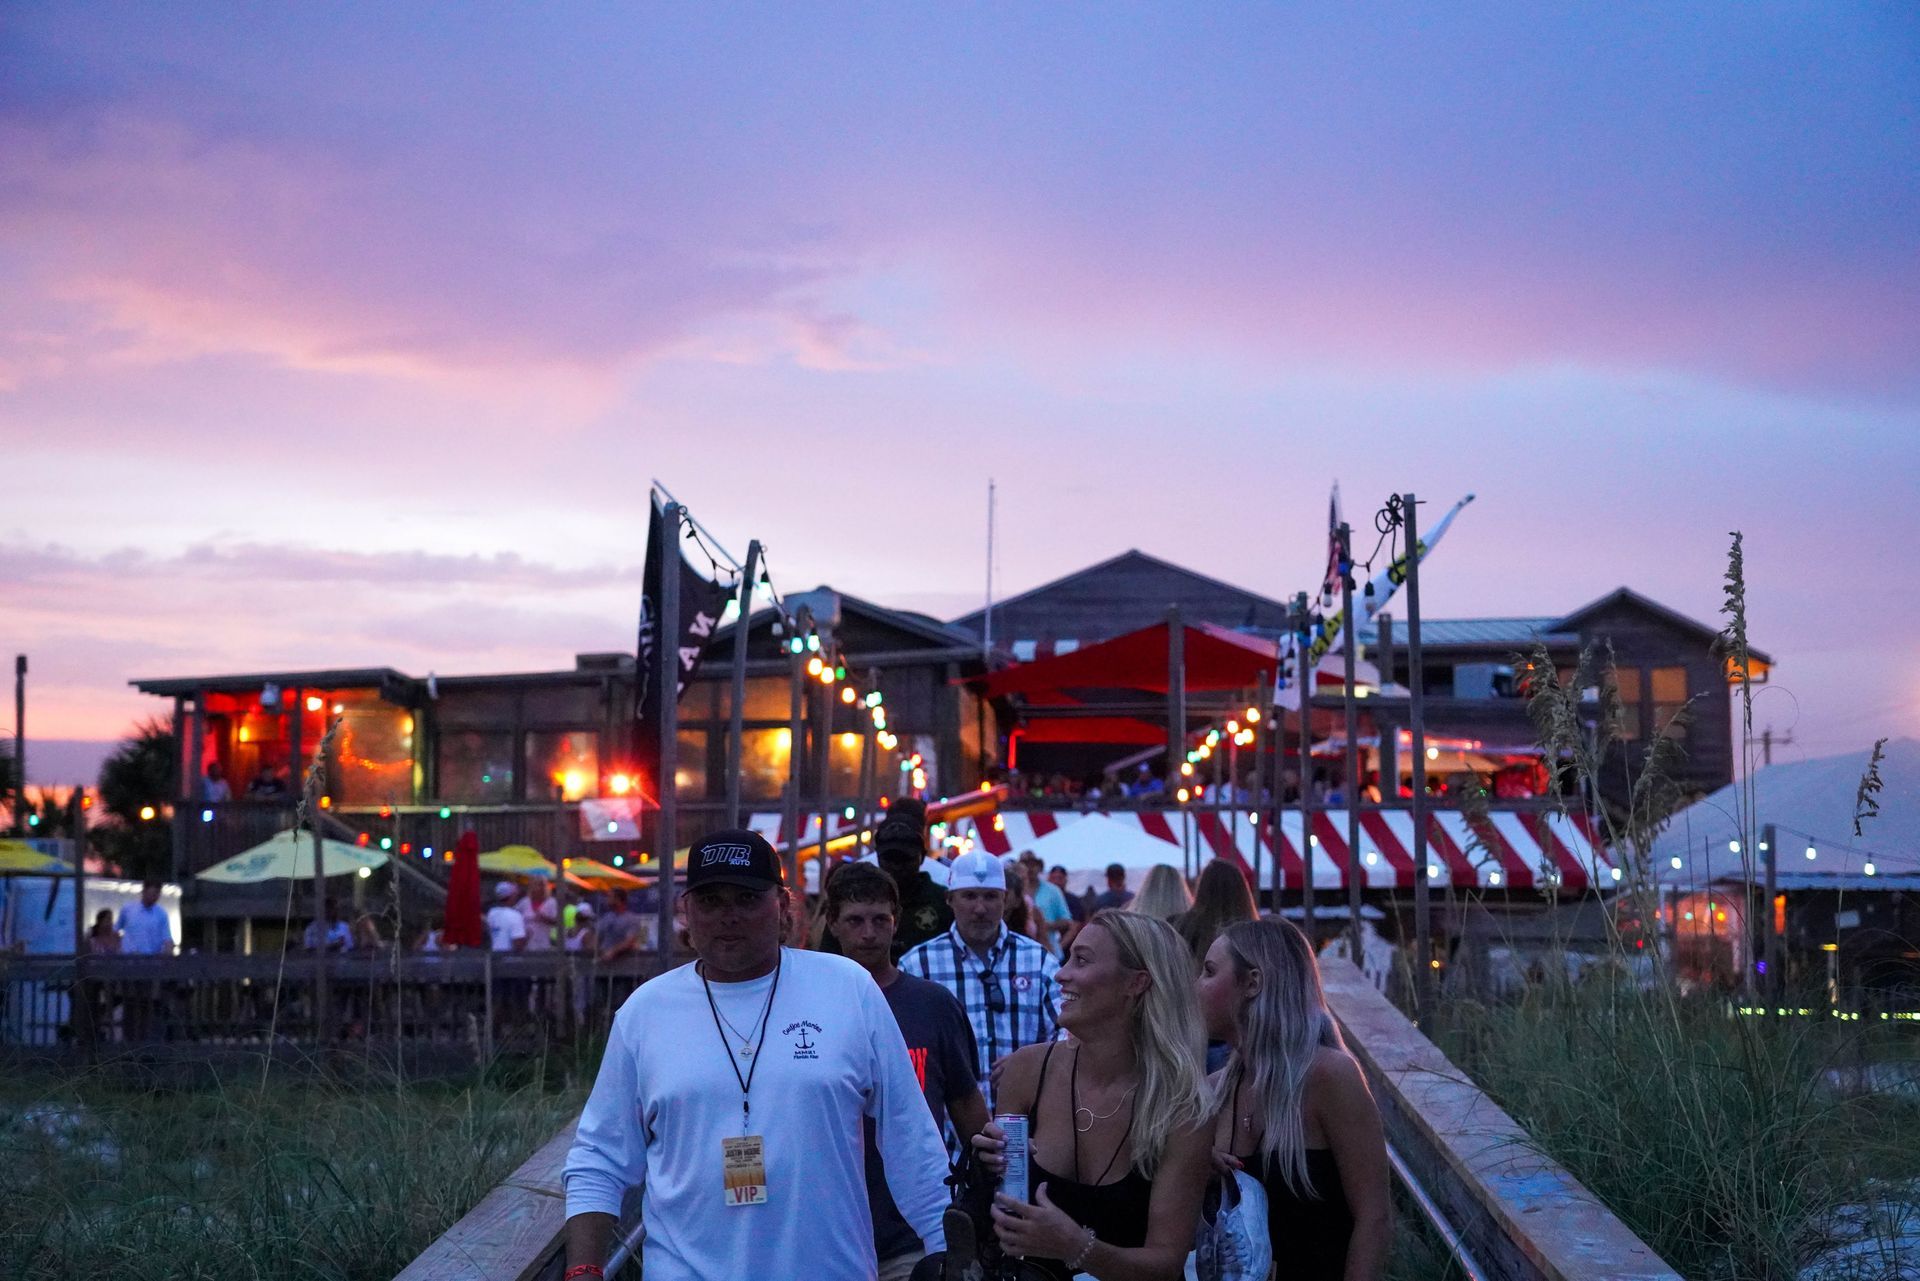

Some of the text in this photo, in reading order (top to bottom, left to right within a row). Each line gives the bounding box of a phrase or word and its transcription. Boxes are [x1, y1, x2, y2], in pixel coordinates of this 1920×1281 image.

[730, 859, 750, 867] AUTO
[801, 1020, 822, 1034] Marina
[734, 1186, 757, 1203] VIP
